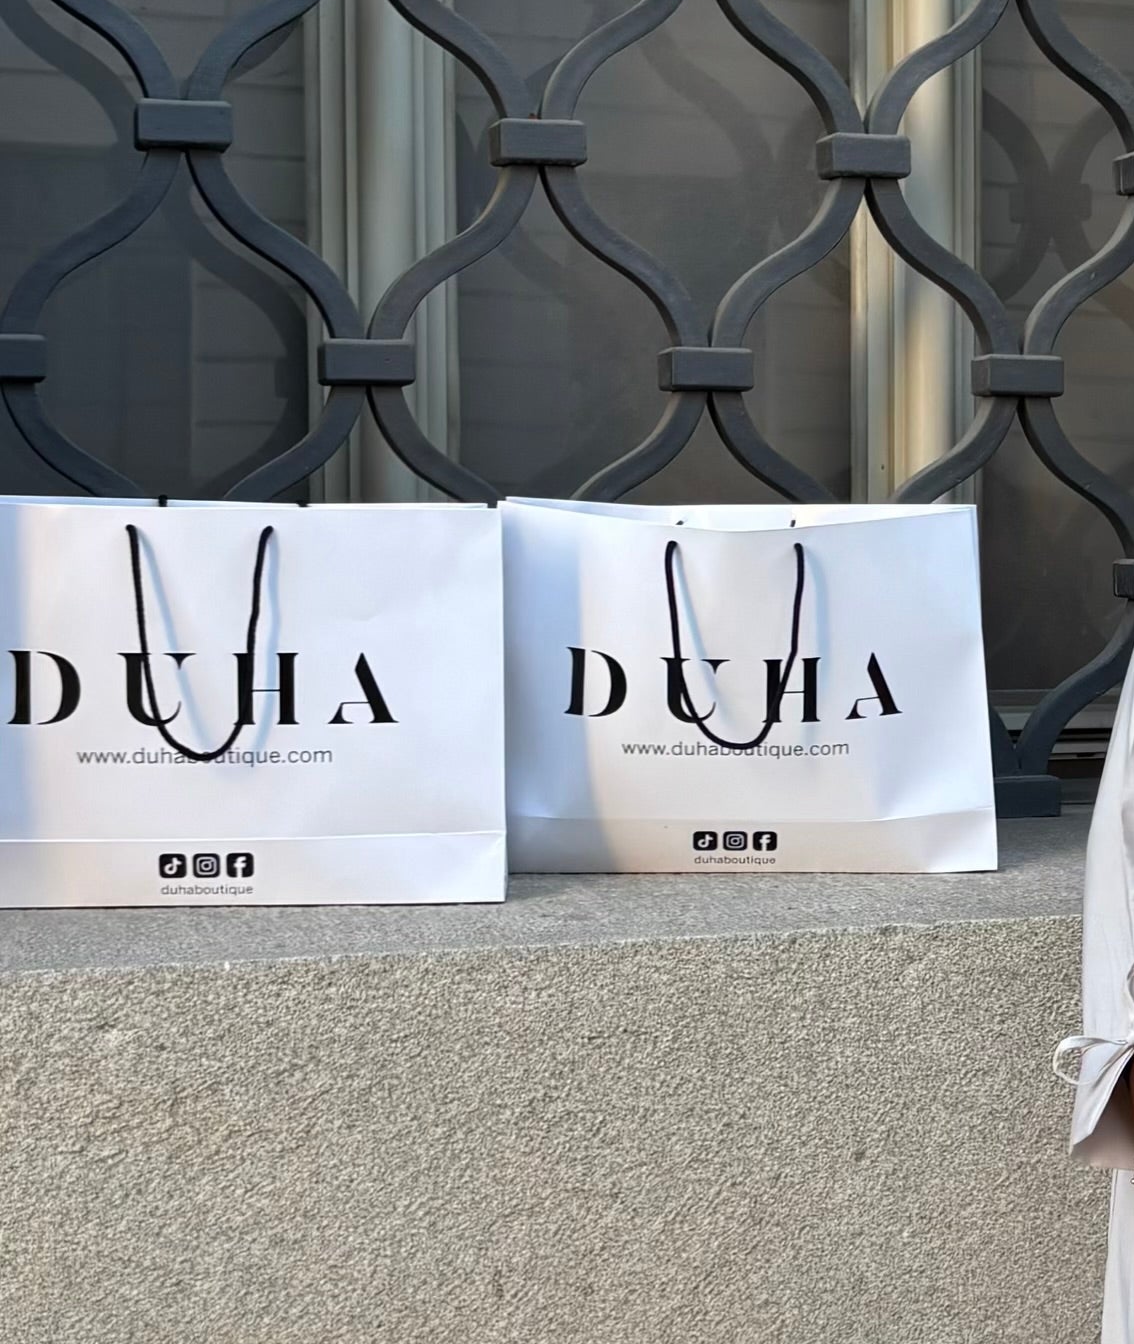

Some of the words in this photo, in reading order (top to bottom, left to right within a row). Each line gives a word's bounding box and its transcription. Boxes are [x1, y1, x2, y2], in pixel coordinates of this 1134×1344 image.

[7, 649, 400, 725] DUHA
[563, 646, 903, 723] DUHA
[76, 747, 334, 768] www.duhautique.com
[693, 855, 776, 866] duhaboutique
[160, 884, 254, 896] duhaboutique
